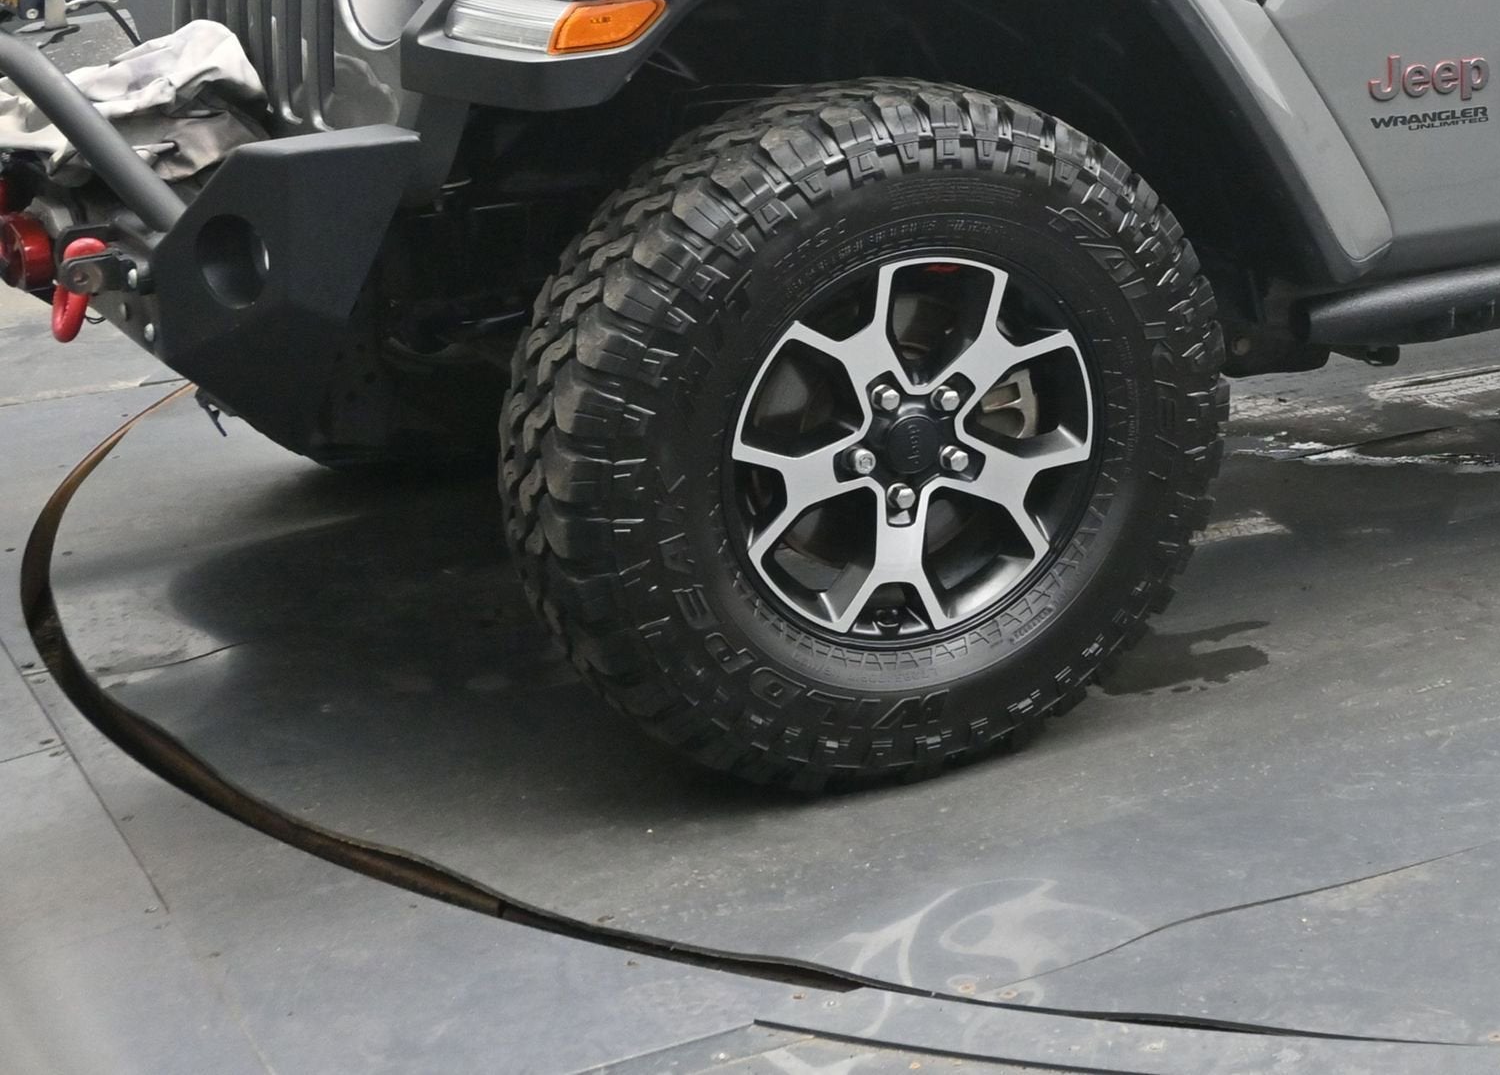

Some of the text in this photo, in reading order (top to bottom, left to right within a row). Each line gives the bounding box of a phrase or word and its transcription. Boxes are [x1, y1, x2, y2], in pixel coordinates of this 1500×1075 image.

[1368, 54, 1489, 102] Jeep
[1370, 106, 1488, 129] WRANGLER
[1408, 116, 1489, 131] UNLIMITED
[1043, 205, 1181, 481] FALKEN
[655, 465, 952, 731] WILDPEAK
